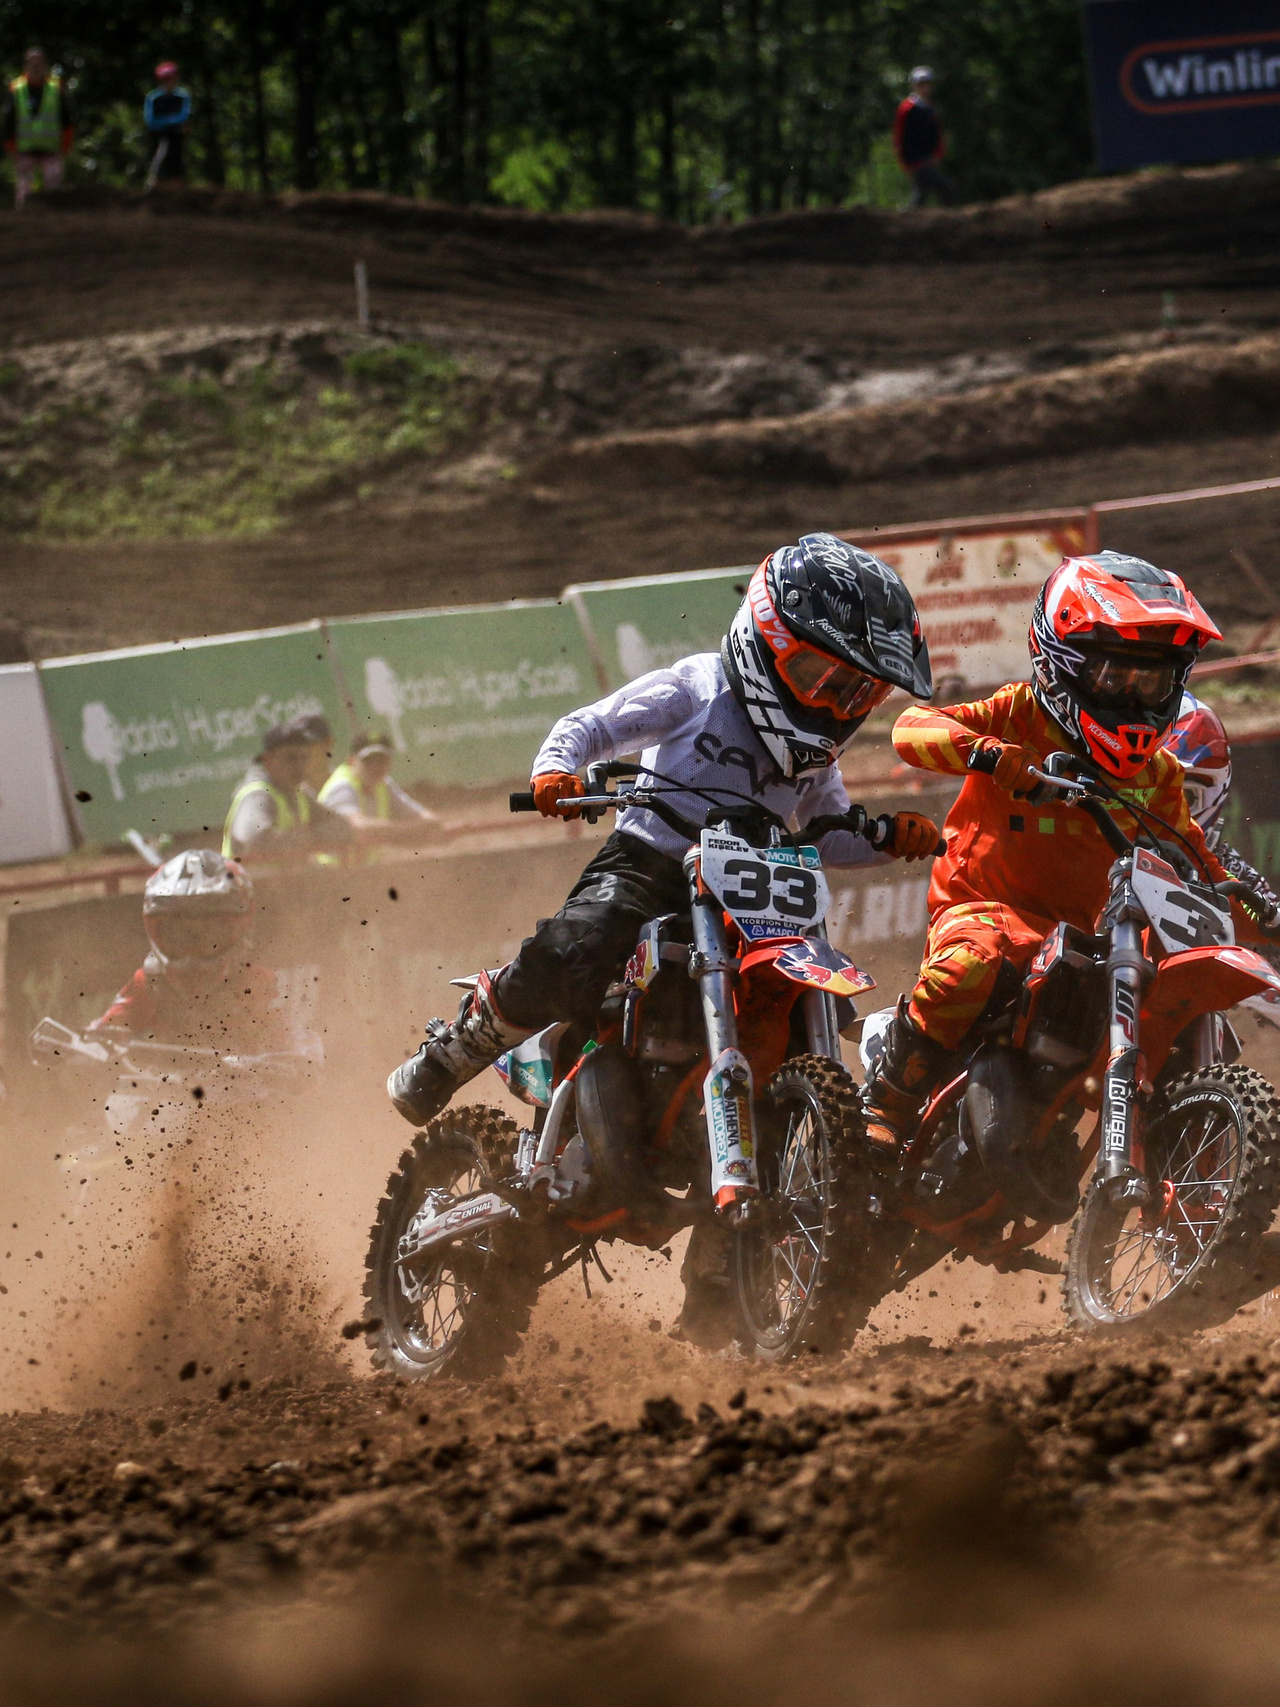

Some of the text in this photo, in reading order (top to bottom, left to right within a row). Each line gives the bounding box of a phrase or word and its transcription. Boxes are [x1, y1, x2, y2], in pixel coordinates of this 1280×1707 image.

[883, 658, 914, 682] BELL
[1087, 722, 1123, 752] УССУРИЙСК
[707, 838, 741, 847] FEDOR
[707, 844, 750, 854] KISELEV
[766, 850, 821, 868] MOTOEX
[722, 858, 818, 920] 33
[779, 921, 799, 930] BAY
[1158, 890, 1224, 948] 3
[1115, 978, 1135, 1045] WP
[712, 1098, 728, 1163] MOTOREX
[724, 1099, 739, 1148] ATHENA
